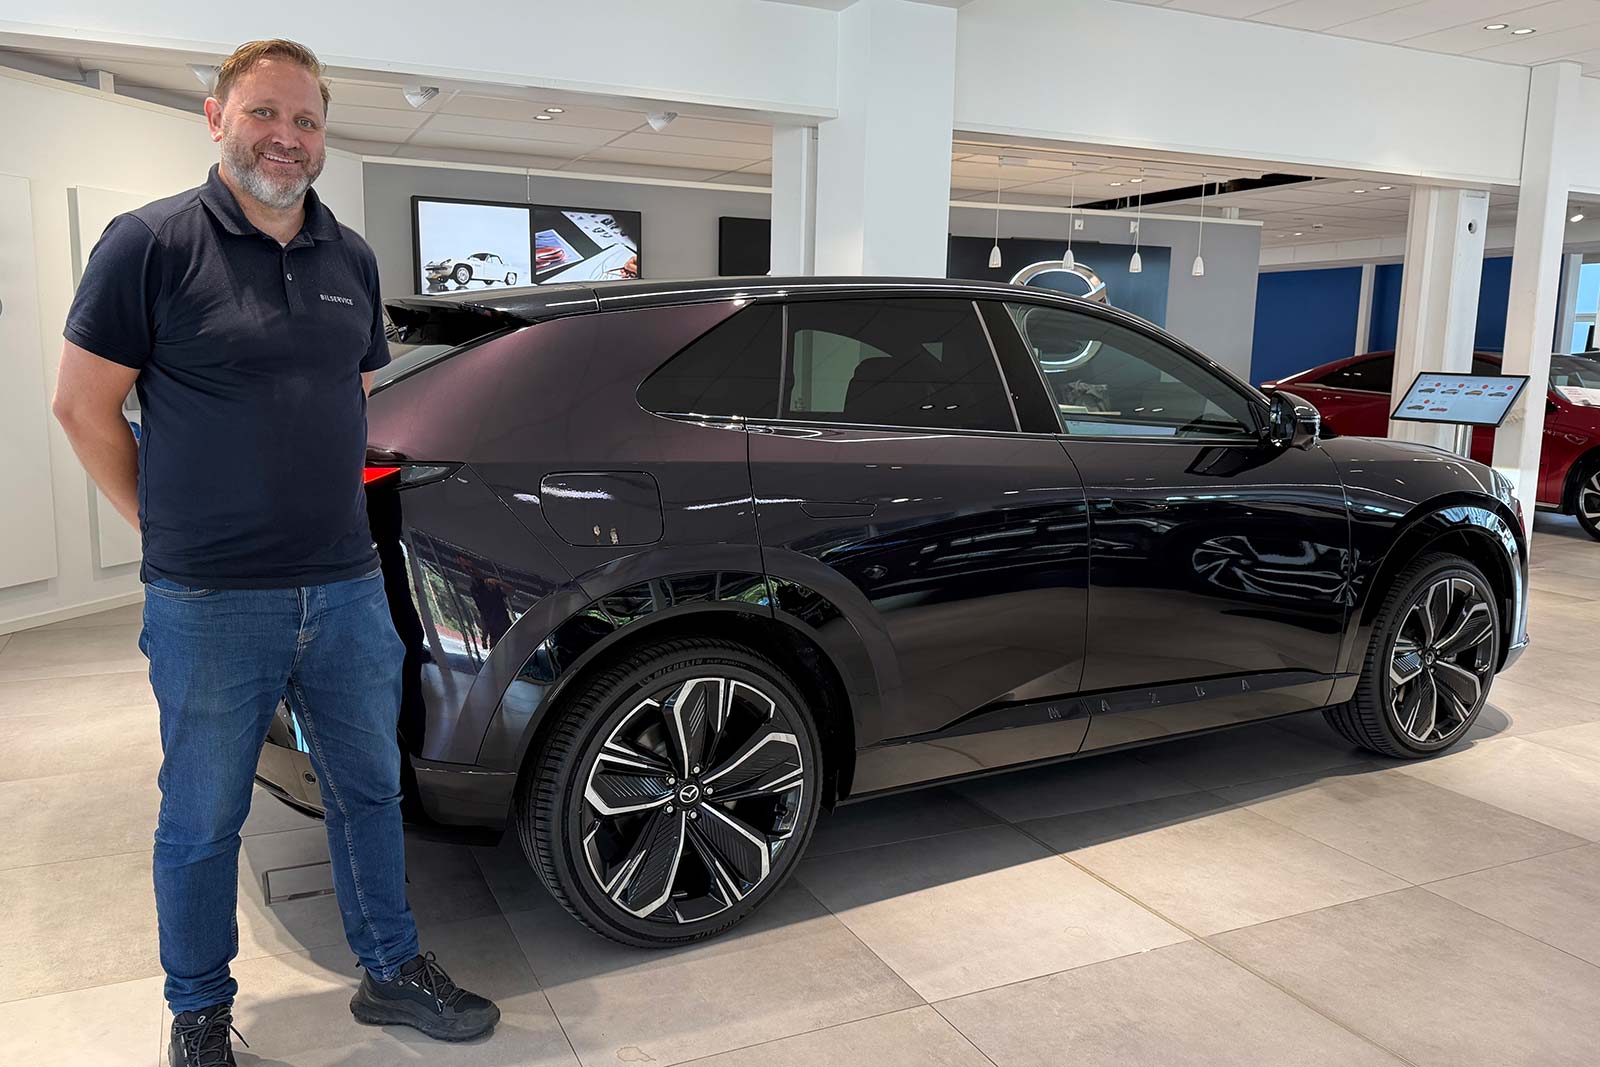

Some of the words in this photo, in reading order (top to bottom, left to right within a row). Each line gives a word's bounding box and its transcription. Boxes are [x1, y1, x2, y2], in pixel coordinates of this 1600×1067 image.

[320, 294, 354, 306] BILSERVICE
[653, 658, 703, 679] MICHELIN
[1047, 679, 1251, 720] MAZDA
